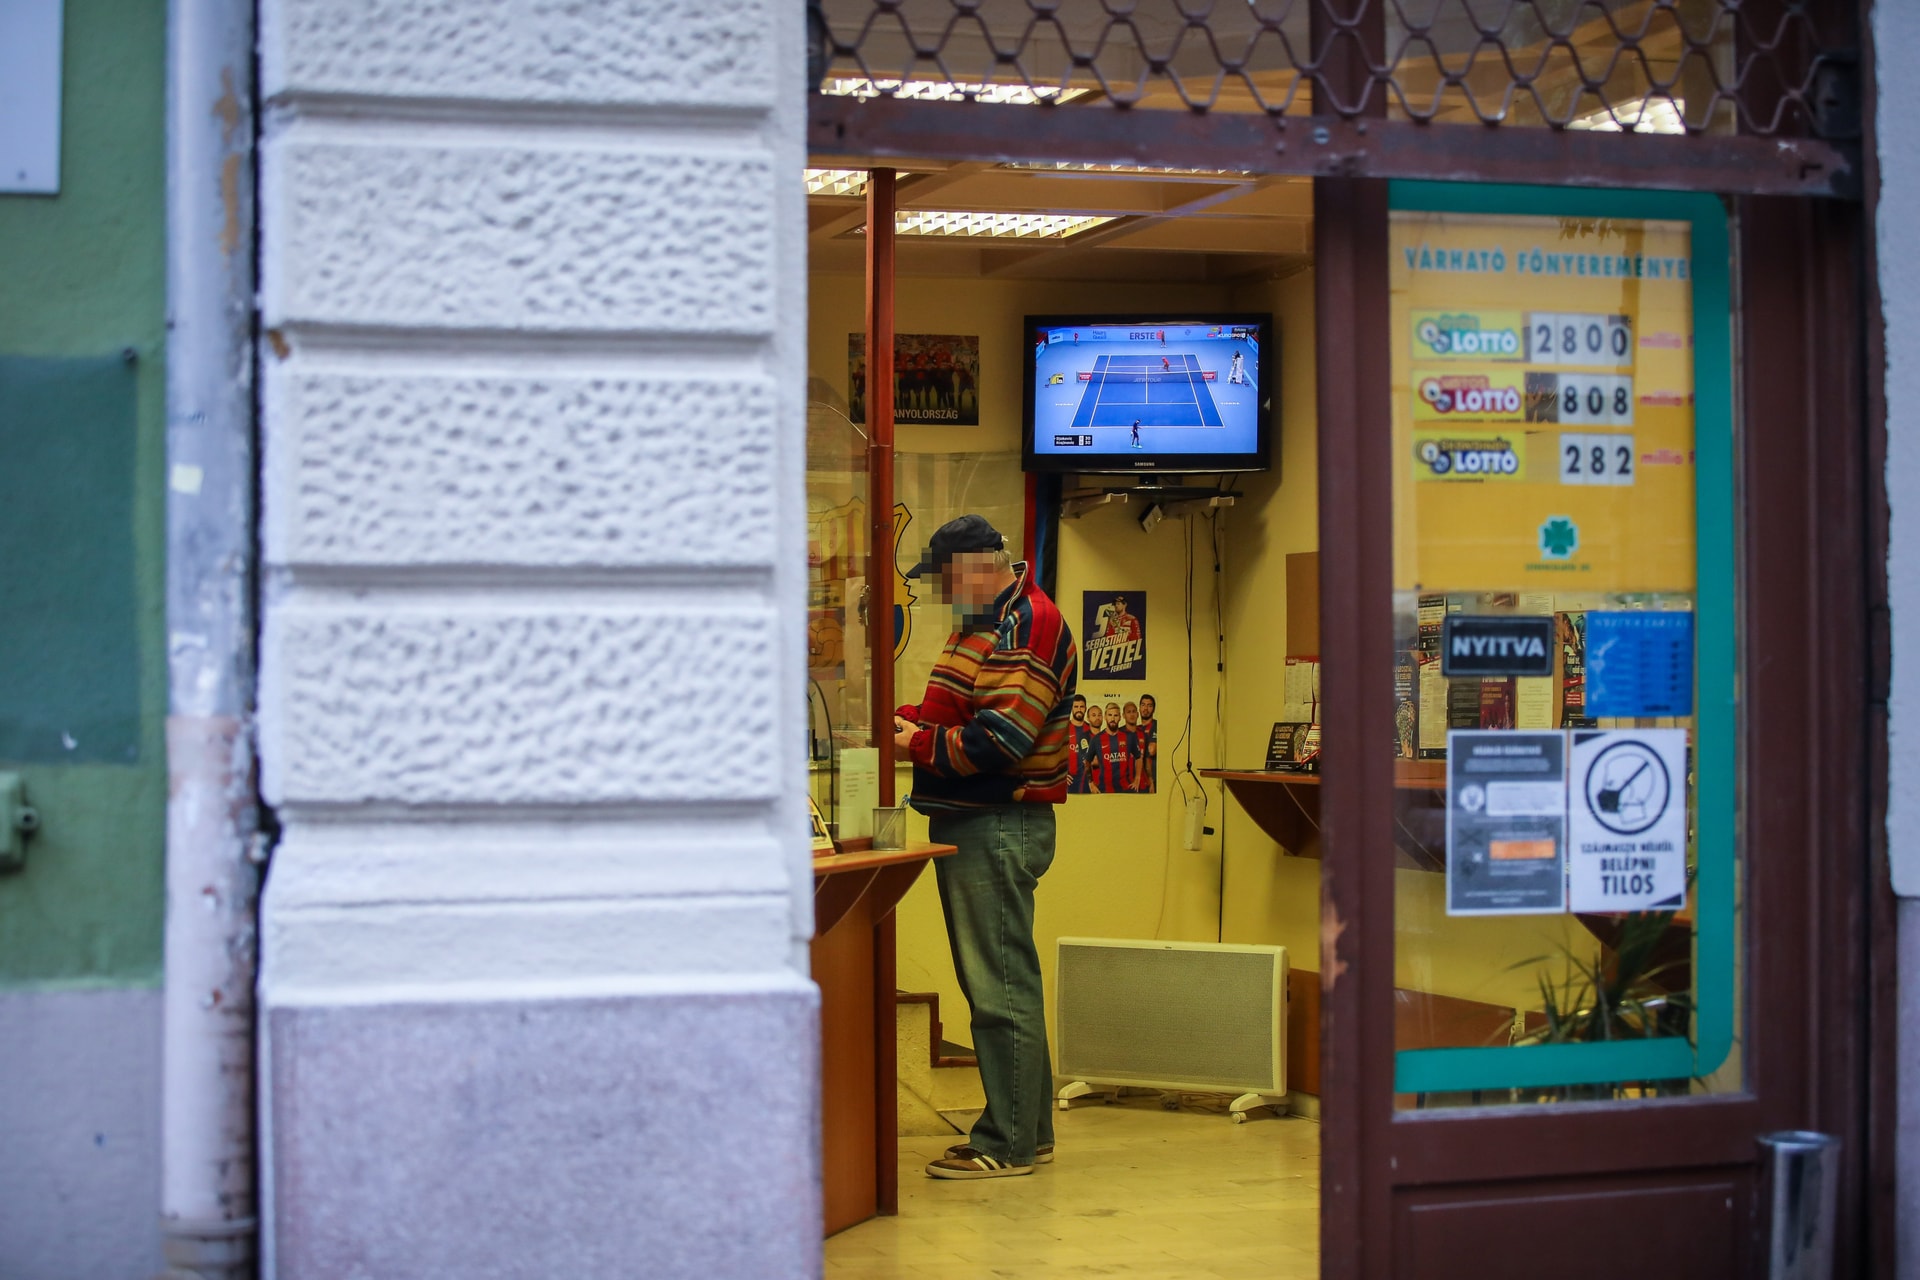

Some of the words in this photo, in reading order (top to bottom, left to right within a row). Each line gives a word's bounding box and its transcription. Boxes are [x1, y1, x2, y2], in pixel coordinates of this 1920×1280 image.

[1405, 244, 1506, 272] VÁRHATÓ
[1130, 332, 1154, 340] ERSTE
[1536, 324, 1628, 356] 2800
[1563, 386, 1628, 415] 808
[1566, 445, 1631, 474] 282
[1085, 632, 1129, 651] SEBASTIAN
[1453, 636, 1545, 657] NYITVA
[1090, 639, 1142, 671] VETTEL
[1104, 752, 1126, 760] QATAR
[1601, 855, 1655, 871] BELÉPNI
[1602, 874, 1653, 894] TILOS
